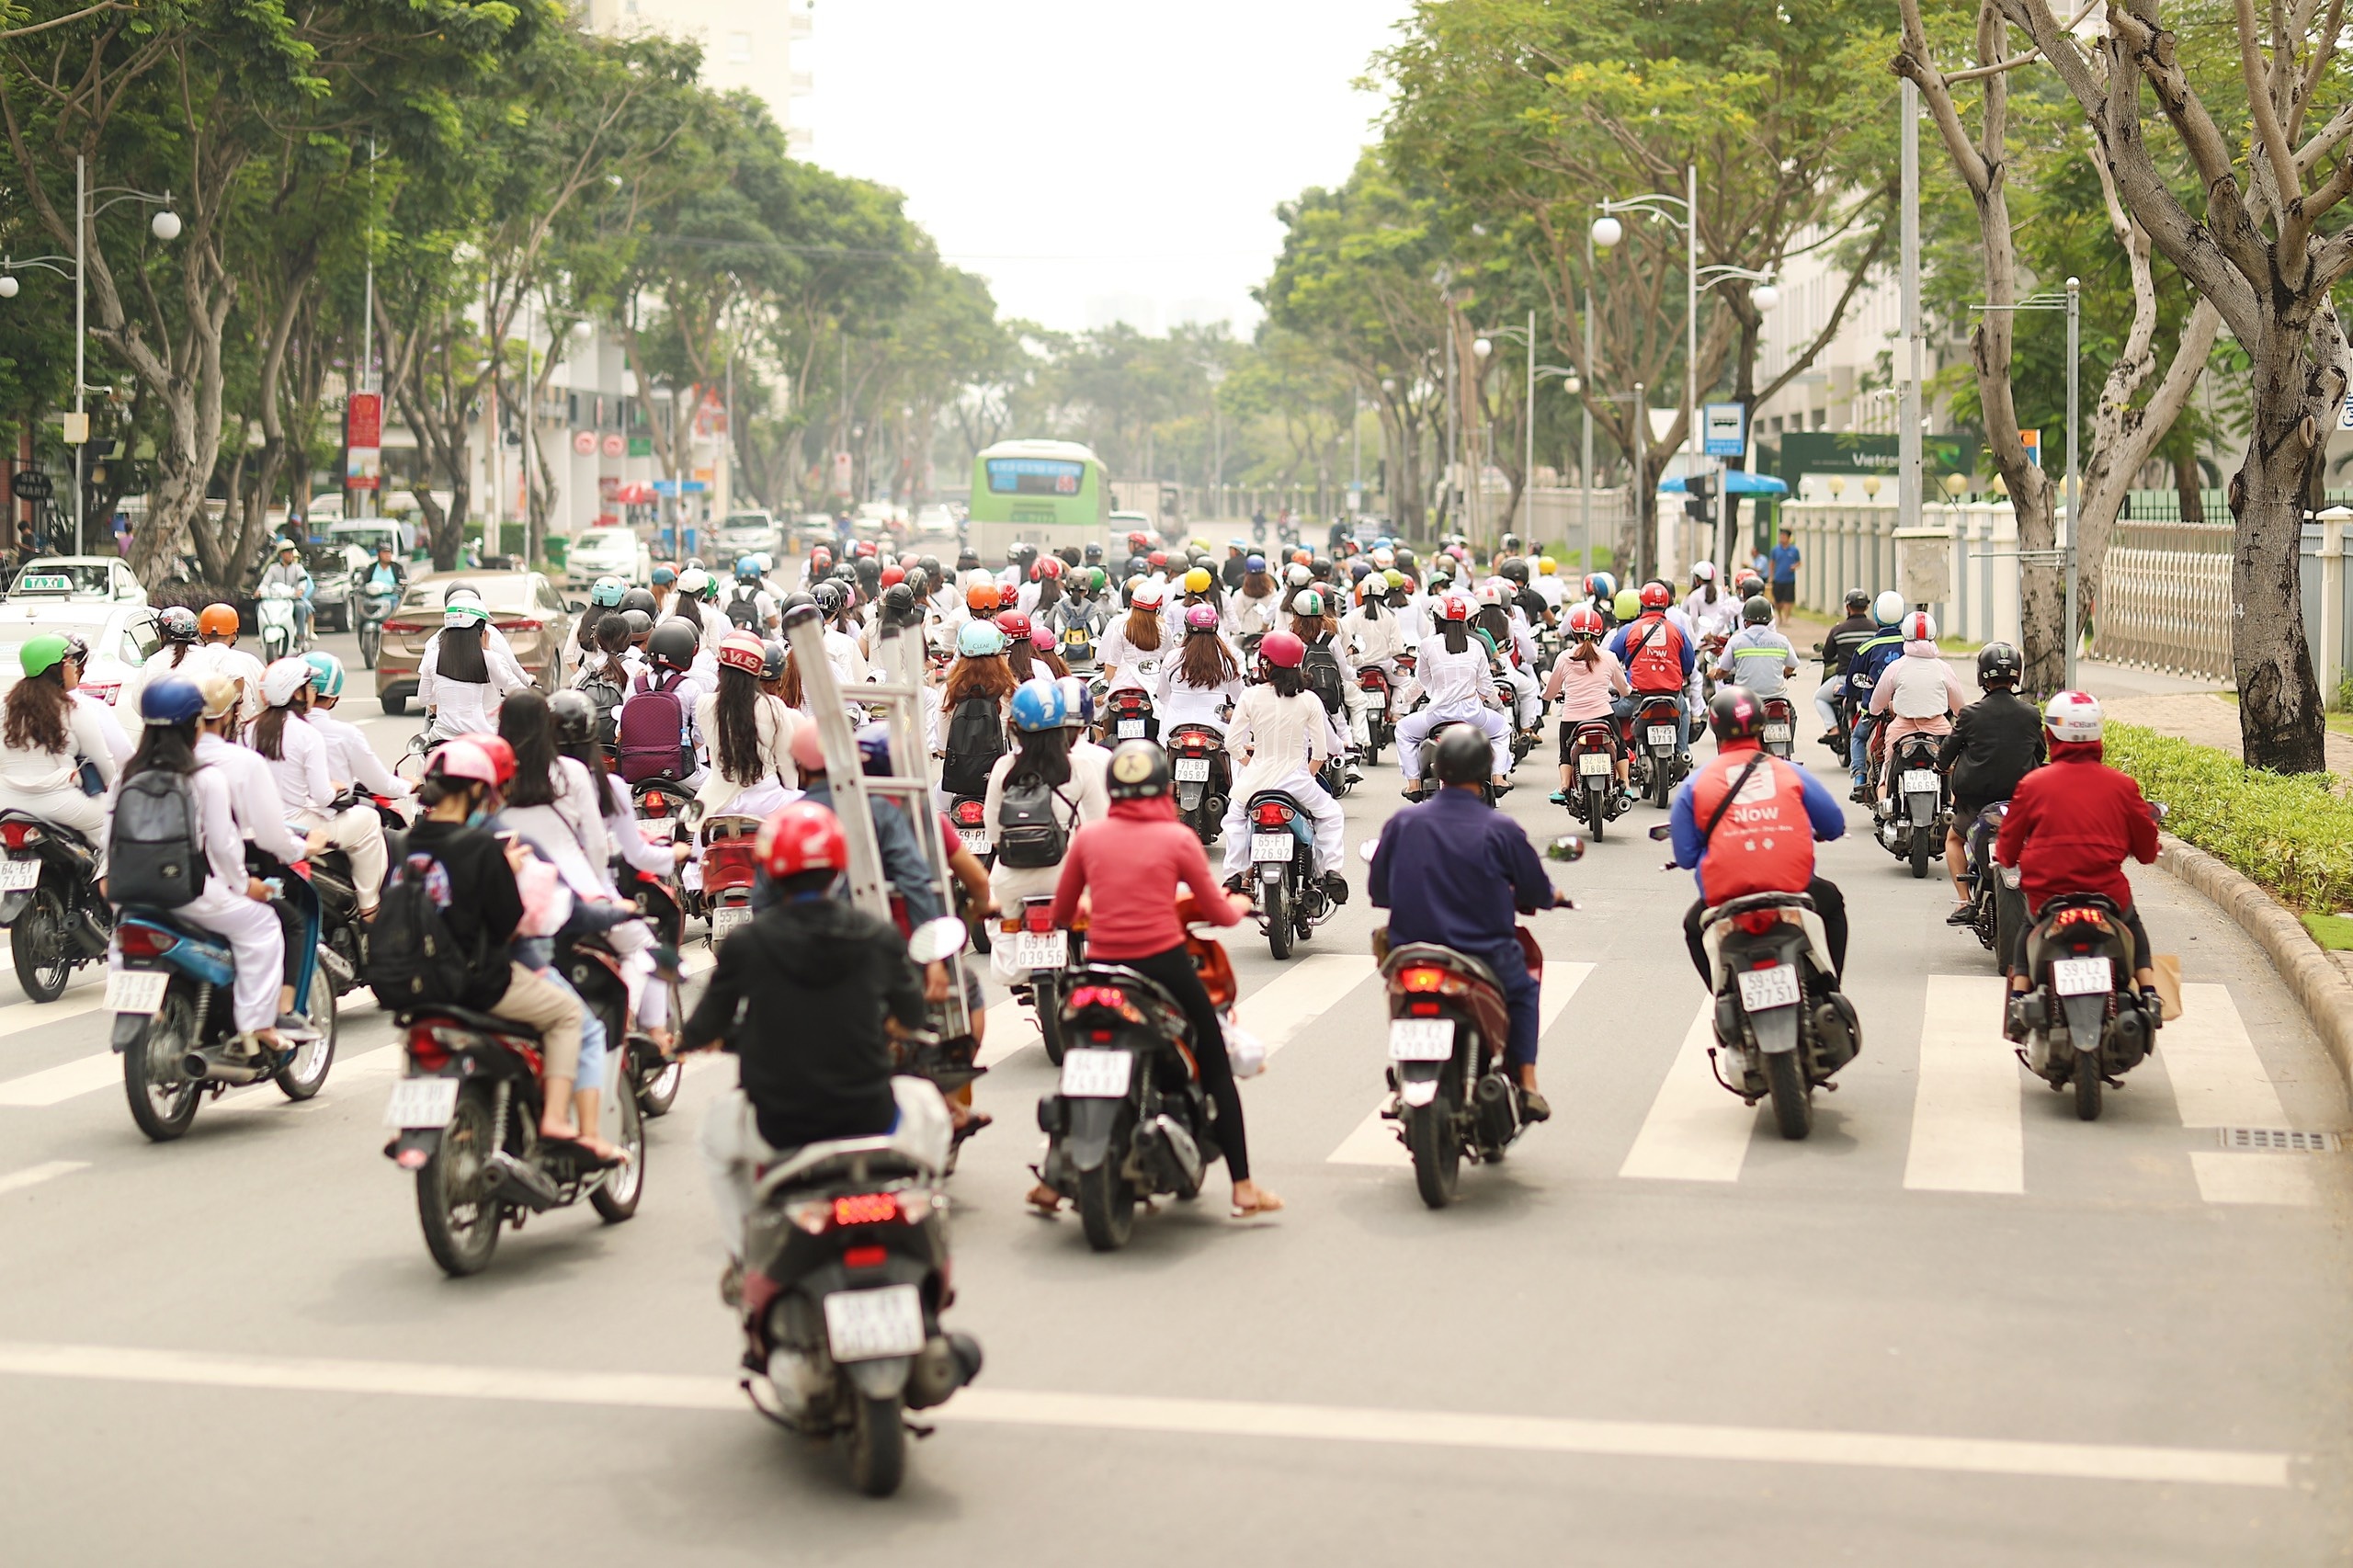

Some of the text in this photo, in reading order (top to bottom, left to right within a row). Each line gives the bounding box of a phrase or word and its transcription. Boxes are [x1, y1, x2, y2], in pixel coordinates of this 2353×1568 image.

[21, 473, 42, 483] SKY
[17, 484, 47, 495] MART
[730, 650, 758, 669] VUS
[1181, 761, 1204, 770] 71-B3
[1176, 770, 1207, 780] 795.87
[1909, 771, 1932, 781] 47-B1
[1906, 781, 1936, 791] 646.65
[959, 830, 985, 841] 59-P1
[1258, 835, 1286, 847] 65-F1
[1254, 847, 1290, 859] 226.92
[2, 863, 32, 876] 64-E1
